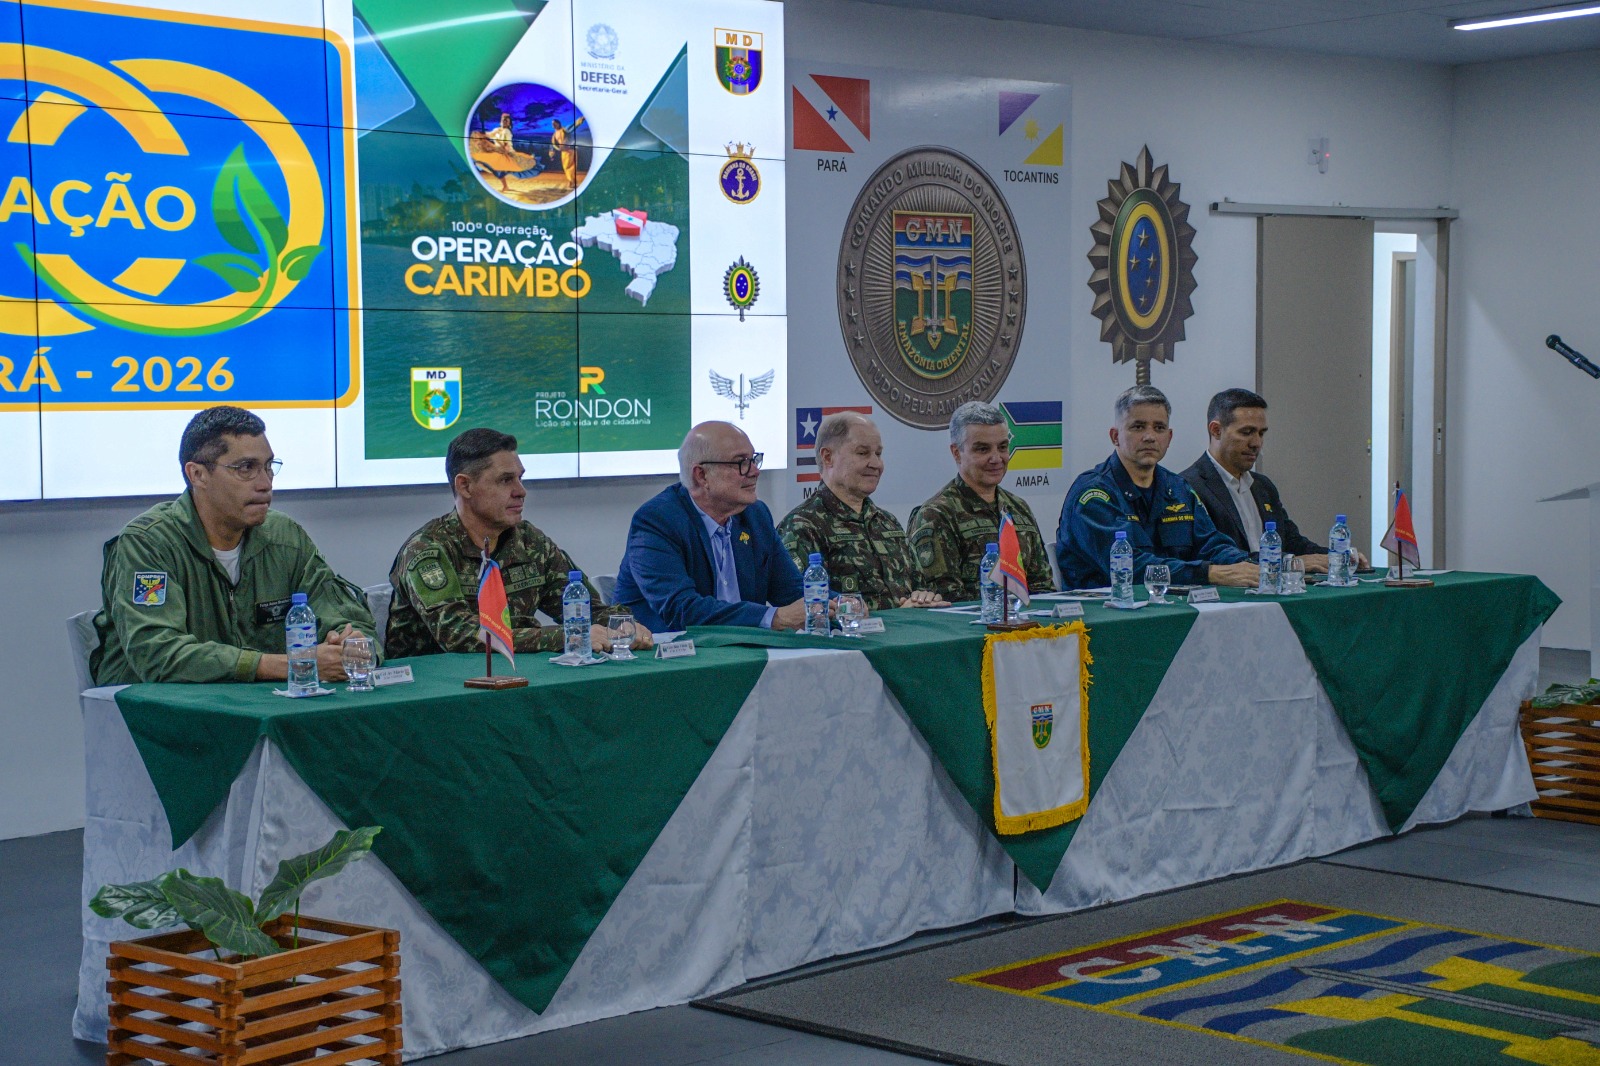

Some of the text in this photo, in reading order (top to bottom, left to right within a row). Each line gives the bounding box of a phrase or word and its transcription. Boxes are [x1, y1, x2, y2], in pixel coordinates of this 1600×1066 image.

[580, 70, 626, 86] DEFESA
[578, 84, 628, 95] Secretaria-Geral
[817, 156, 848, 173] PARÁ
[1003, 169, 1059, 184] TOCANTINS
[0, 171, 196, 237] AÇÃO
[851, 161, 1014, 255] COMANDO MILITAR DO NORTE
[485, 222, 548, 239] Operação
[905, 218, 963, 244] CMN
[411, 234, 584, 269] OPERAÇÃO
[404, 260, 592, 299] CARIMBÓ
[936, 321, 971, 370] ORIENTAL
[76, 370, 93, 379] -
[110, 355, 234, 392] 2026
[426, 370, 447, 380] MD
[535, 391, 567, 399] PROJETO
[865, 358, 901, 402] TUDO
[901, 393, 935, 417] PELA
[535, 398, 651, 419] RONDON
[535, 419, 559, 427] Lição
[612, 418, 651, 426] cidadania
[1015, 472, 1050, 487] AMAPÁ
[1033, 705, 1050, 714] CMN
[1056, 912, 1346, 985] CMN
